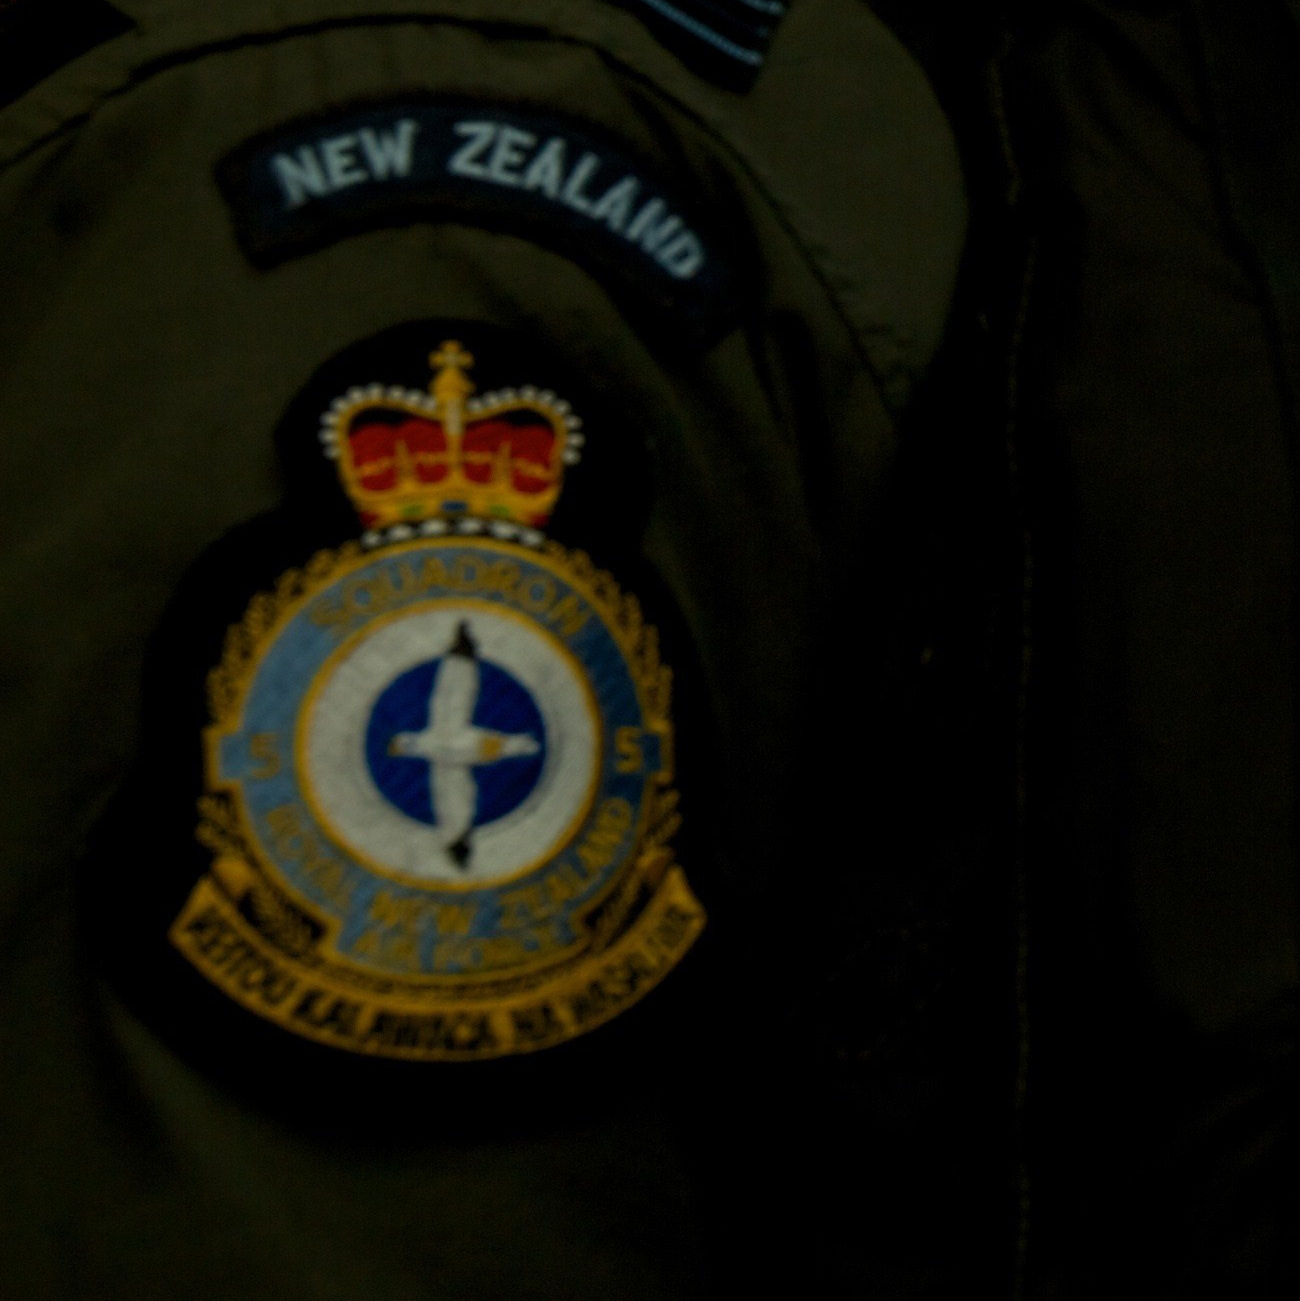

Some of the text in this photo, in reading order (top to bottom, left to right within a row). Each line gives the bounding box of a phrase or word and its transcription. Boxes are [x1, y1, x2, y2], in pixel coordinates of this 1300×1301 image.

[270, 117, 705, 281] NEW ZEALAND
[309, 553, 592, 638] SQUADRON
[250, 733, 281, 779] 5
